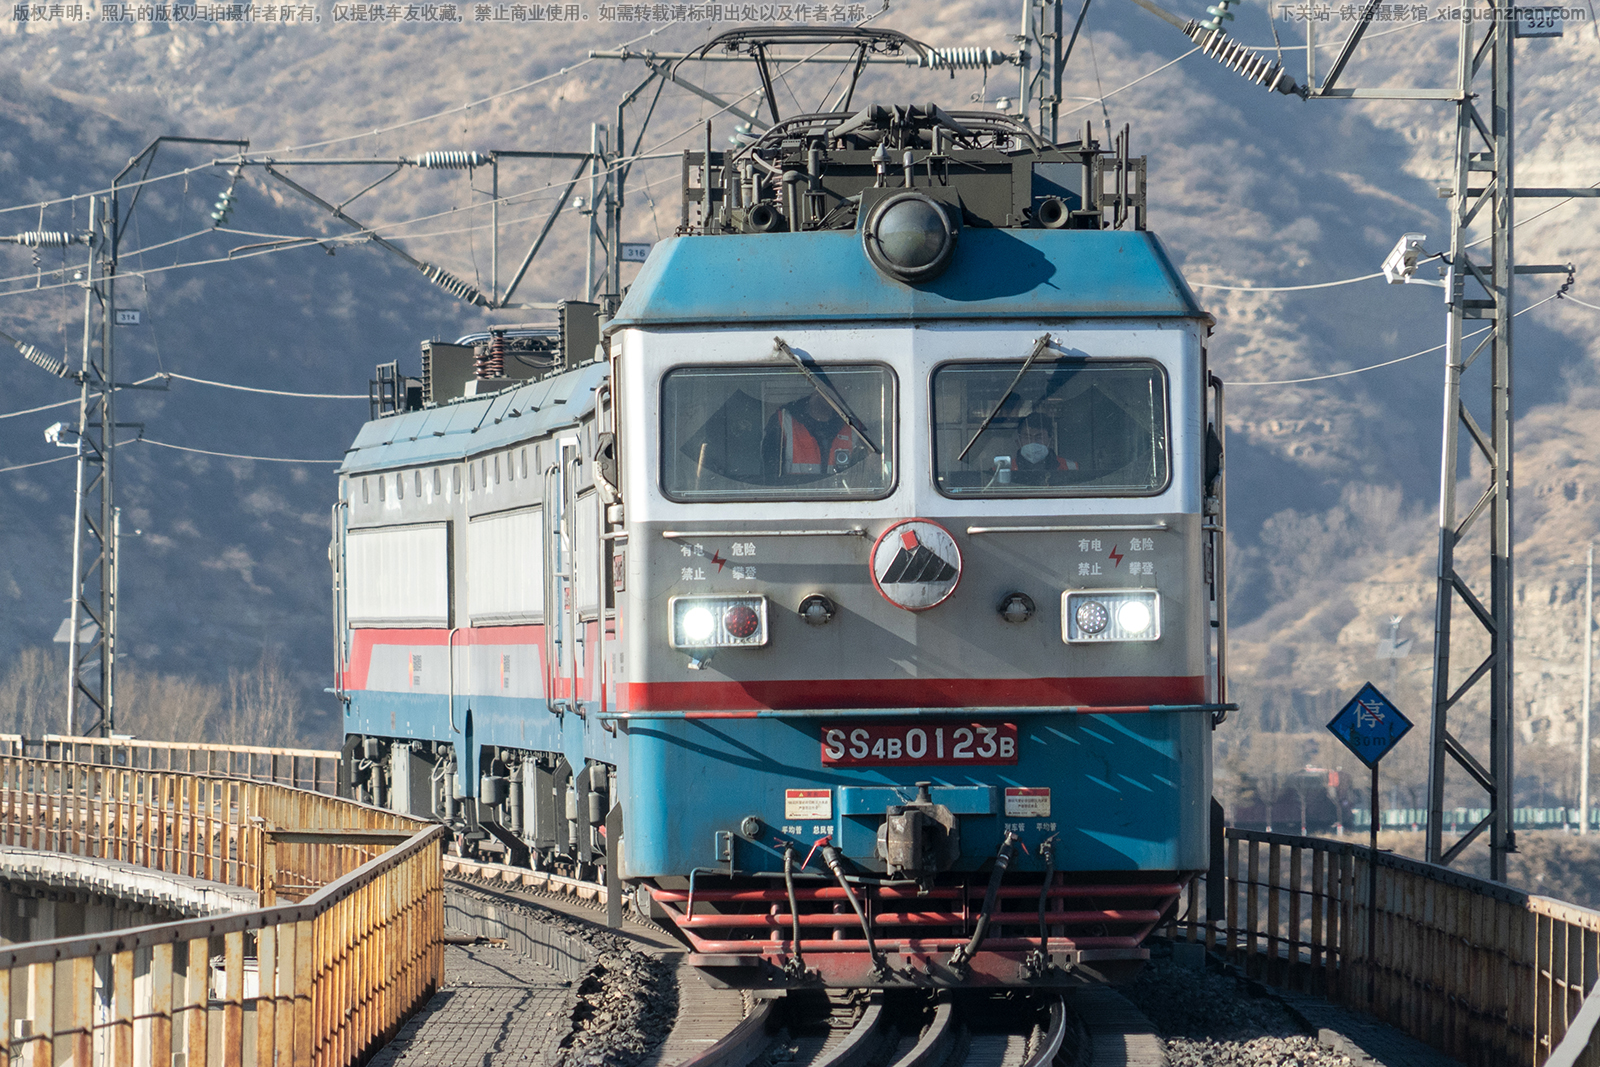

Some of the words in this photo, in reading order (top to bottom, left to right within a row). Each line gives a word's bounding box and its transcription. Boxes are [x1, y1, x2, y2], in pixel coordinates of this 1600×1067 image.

[1528, 17, 1554, 28] 320
[628, 249, 645, 257] 316
[680, 543, 705, 557] 有电
[731, 542, 756, 556] 危险
[1078, 538, 1103, 552] 有电
[1130, 537, 1154, 551] 危险
[681, 567, 706, 581] 禁止
[732, 566, 757, 580] 攀登
[1078, 562, 1103, 576] 禁止
[1129, 562, 1154, 576] 攀登
[1353, 699, 1385, 729] 停
[781, 825, 802, 835] 平均管
[1036, 822, 1057, 832] 平均管
